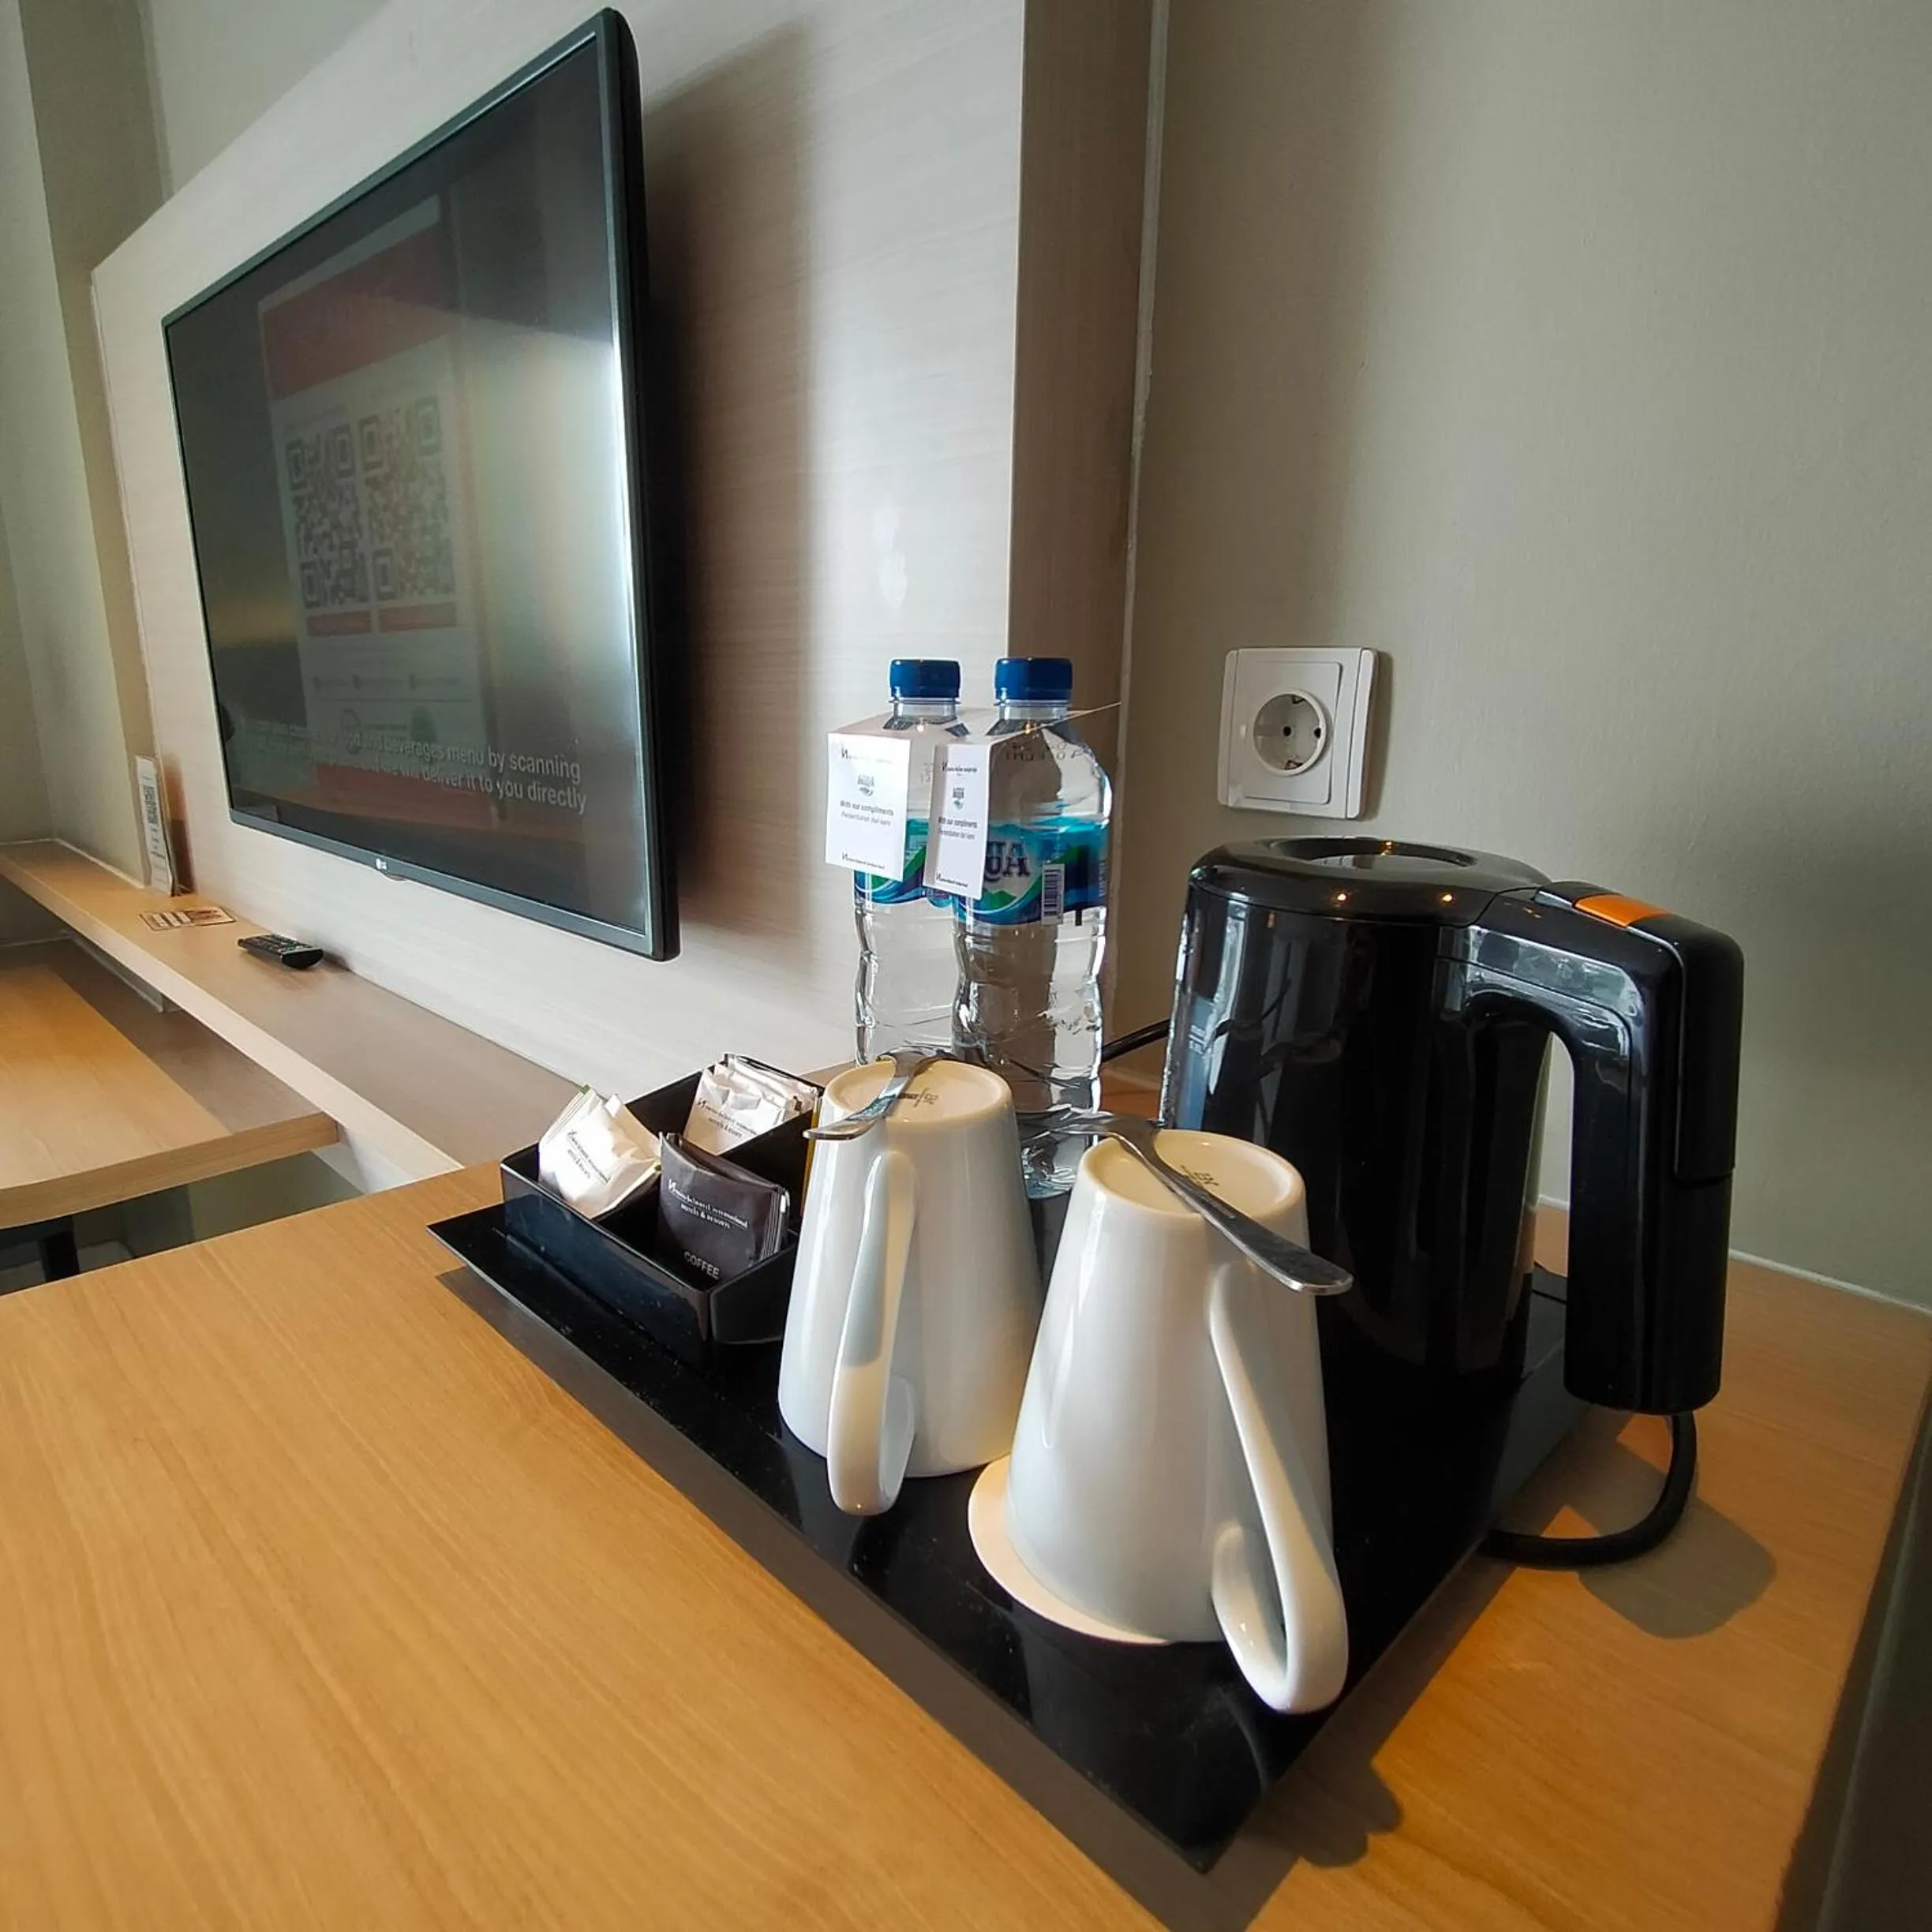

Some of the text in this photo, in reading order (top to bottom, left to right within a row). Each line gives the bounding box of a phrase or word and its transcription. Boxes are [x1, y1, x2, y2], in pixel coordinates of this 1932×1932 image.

[447, 746, 485, 765] menu
[487, 744, 505, 773] by
[509, 753, 582, 785] scanning
[421, 766, 461, 788] deliver
[466, 770, 476, 790] it
[479, 774, 493, 793] to
[496, 780, 523, 800] you
[527, 780, 587, 815] directly
[861, 805, 894, 817] compliments
[983, 840, 1030, 882] UA
[684, 1251, 720, 1279] COFFEE
